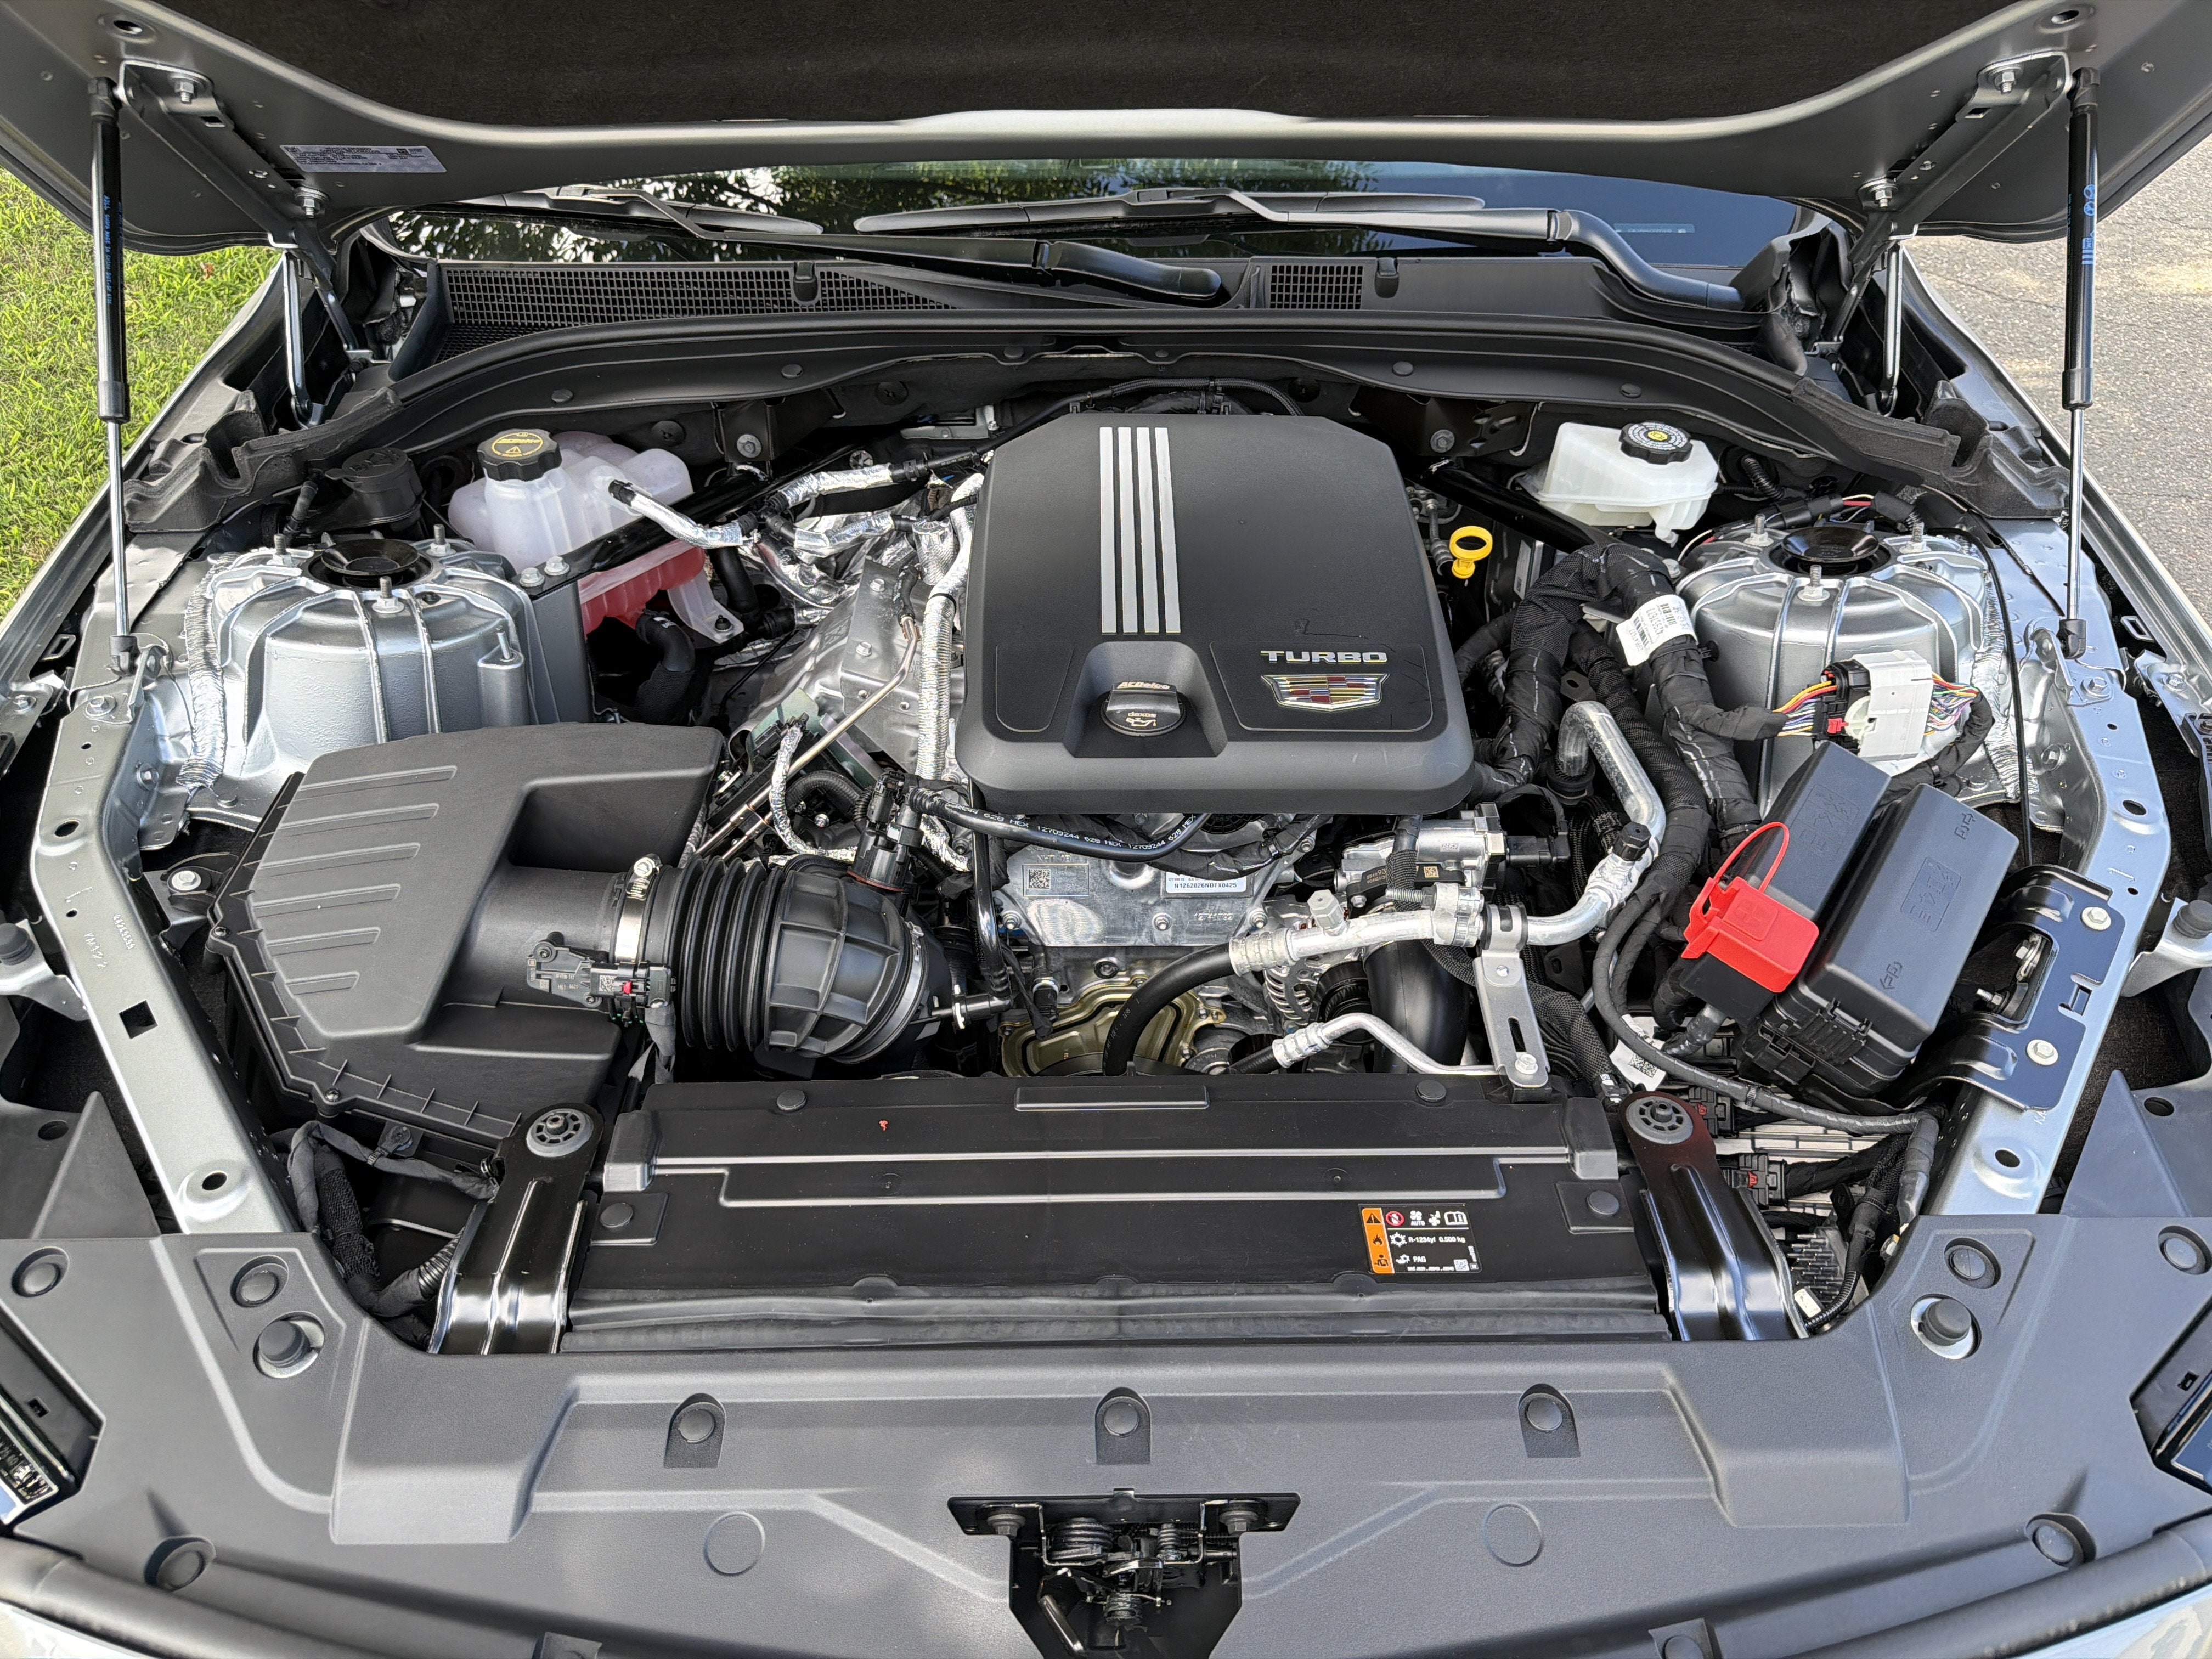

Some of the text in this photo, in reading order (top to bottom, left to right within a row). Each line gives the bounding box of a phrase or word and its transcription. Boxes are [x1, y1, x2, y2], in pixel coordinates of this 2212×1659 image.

[1260, 650, 1387, 663] TURBO
[1116, 681, 1170, 690] ACDelco
[984, 813, 1005, 822] 628
[1009, 819, 1029, 828] MEX
[1036, 825, 1080, 839] 12709244
[1127, 840, 1166, 850] 12709244
[1167, 829, 1182, 841] 628
[1182, 814, 1196, 829] MEX
